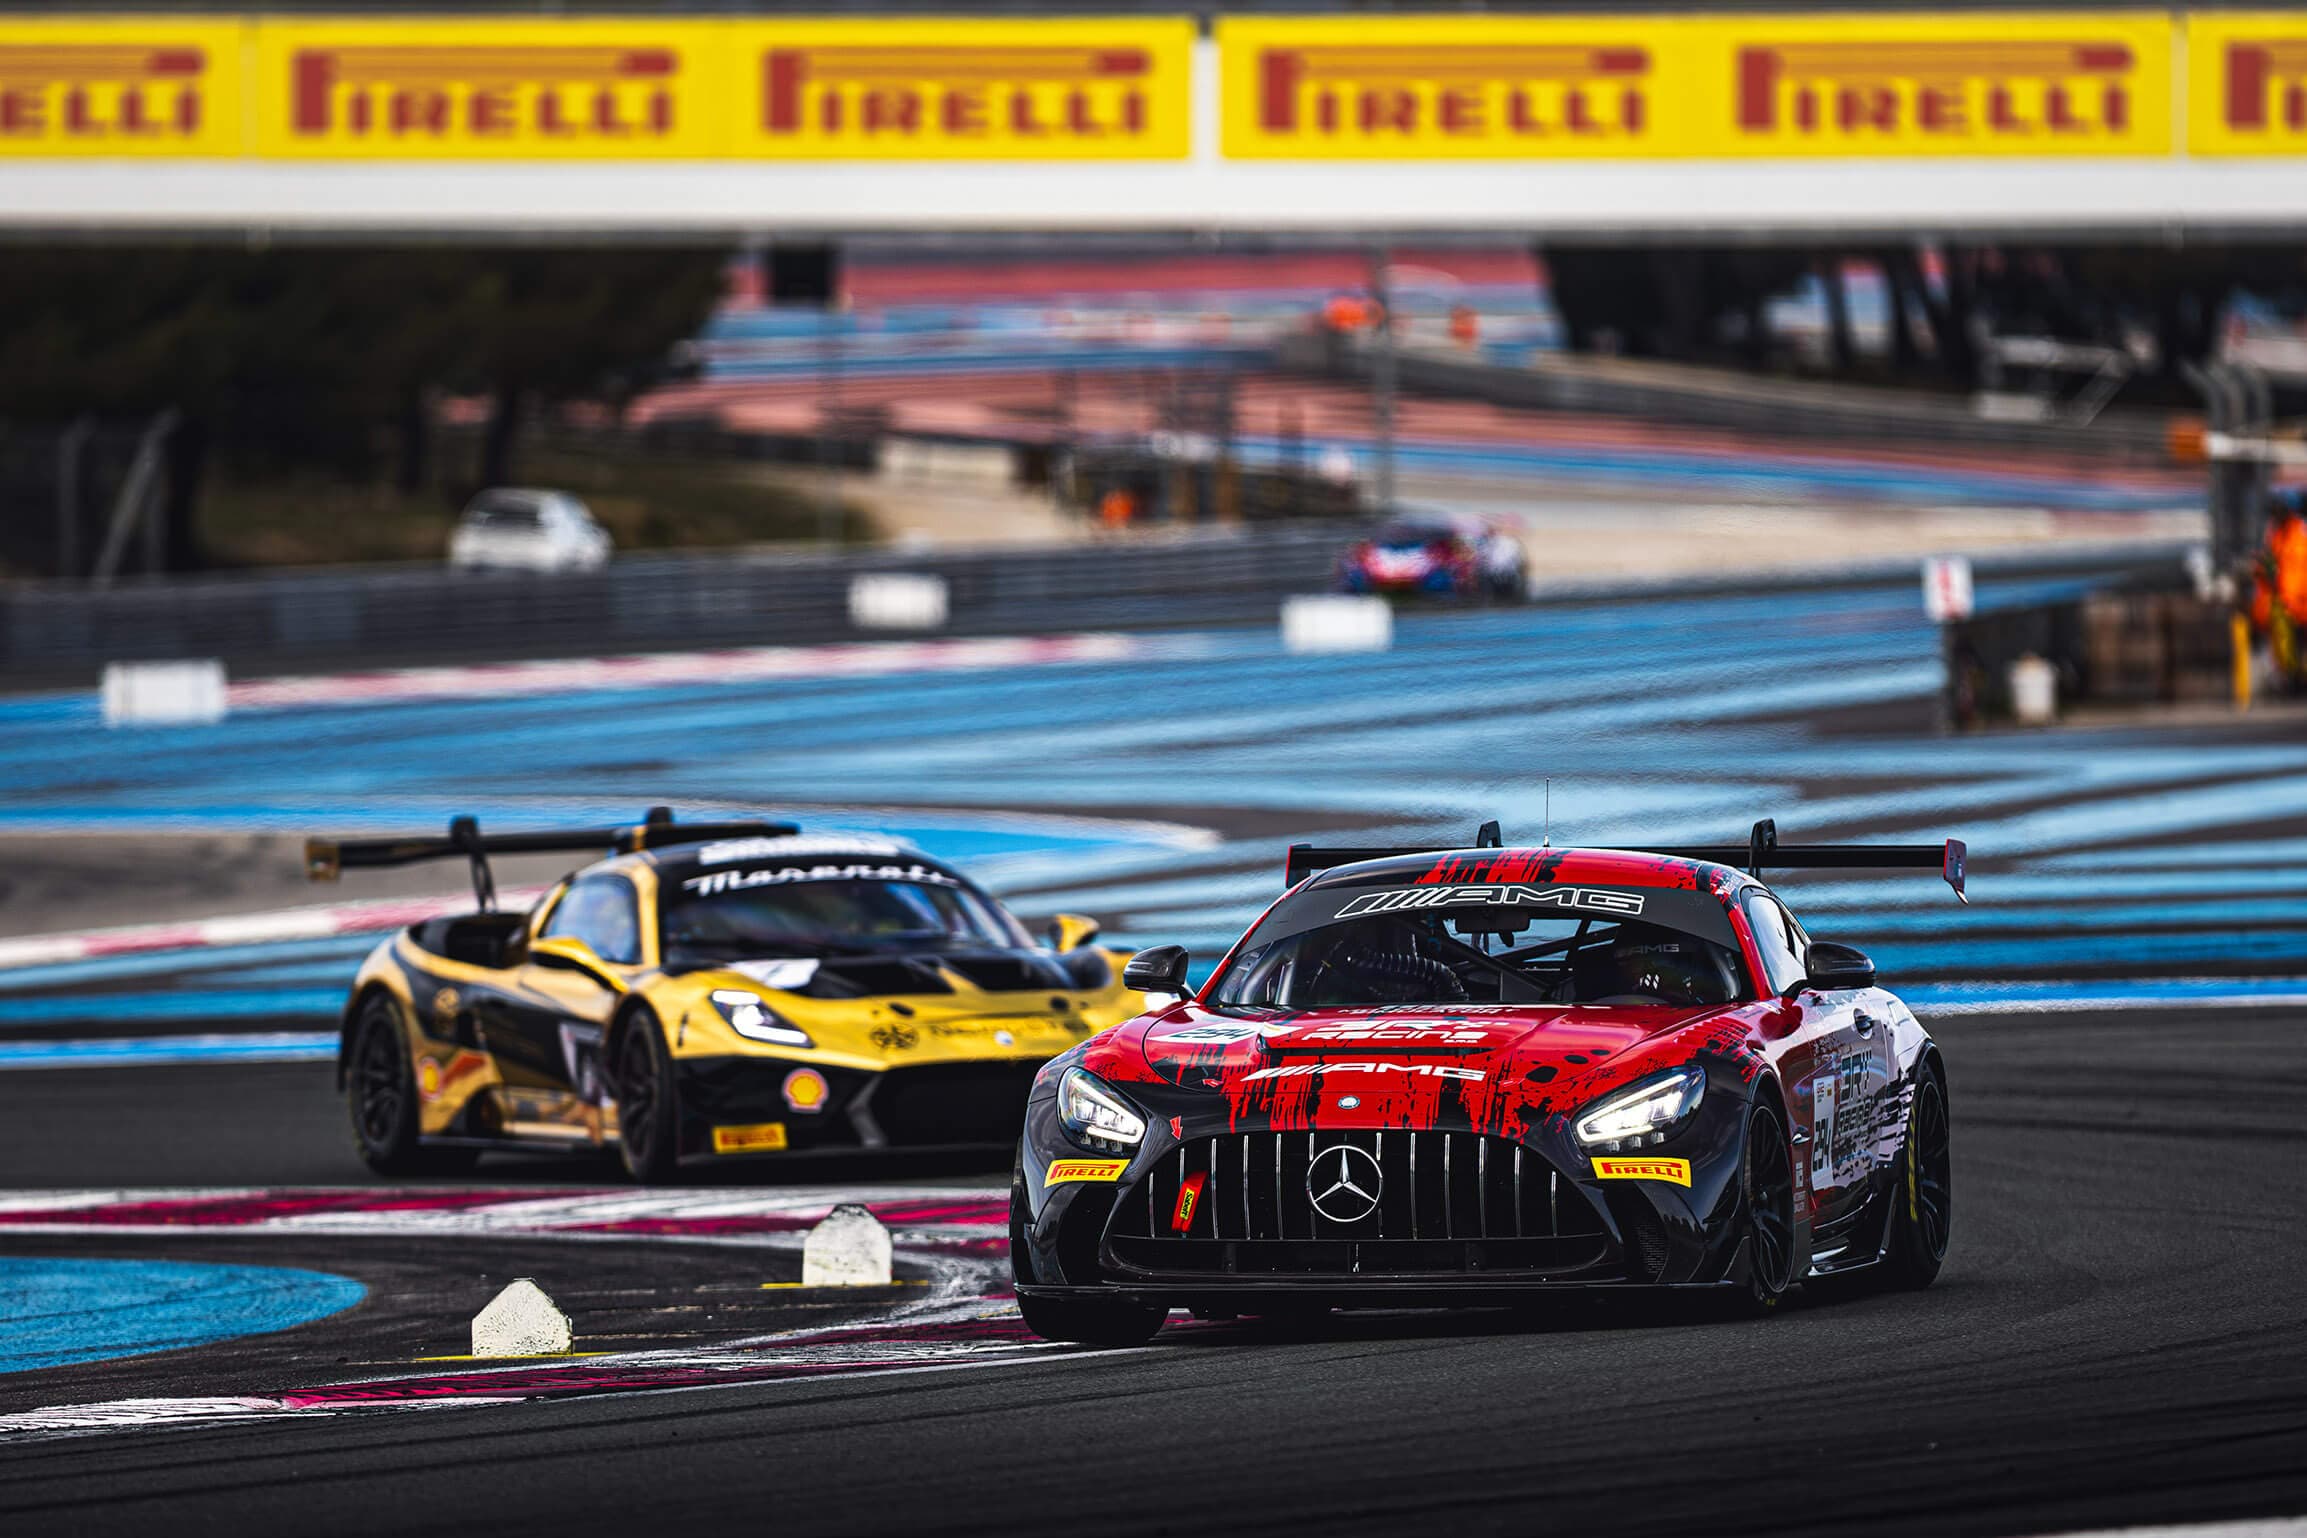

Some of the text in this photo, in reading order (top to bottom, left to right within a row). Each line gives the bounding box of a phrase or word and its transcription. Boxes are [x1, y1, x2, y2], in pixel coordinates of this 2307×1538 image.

[290, 46, 680, 136] PIRELLI
[761, 46, 1152, 136] PIRELLI
[1258, 46, 1650, 135] PIRELLI
[1735, 42, 2135, 134] PIRELLI
[1412, 886, 1645, 915] AMG
[1314, 1062, 1487, 1082] AMG
[1050, 1164, 1120, 1180] PIRELLI
[1601, 1162, 1683, 1178] PIRELLI
